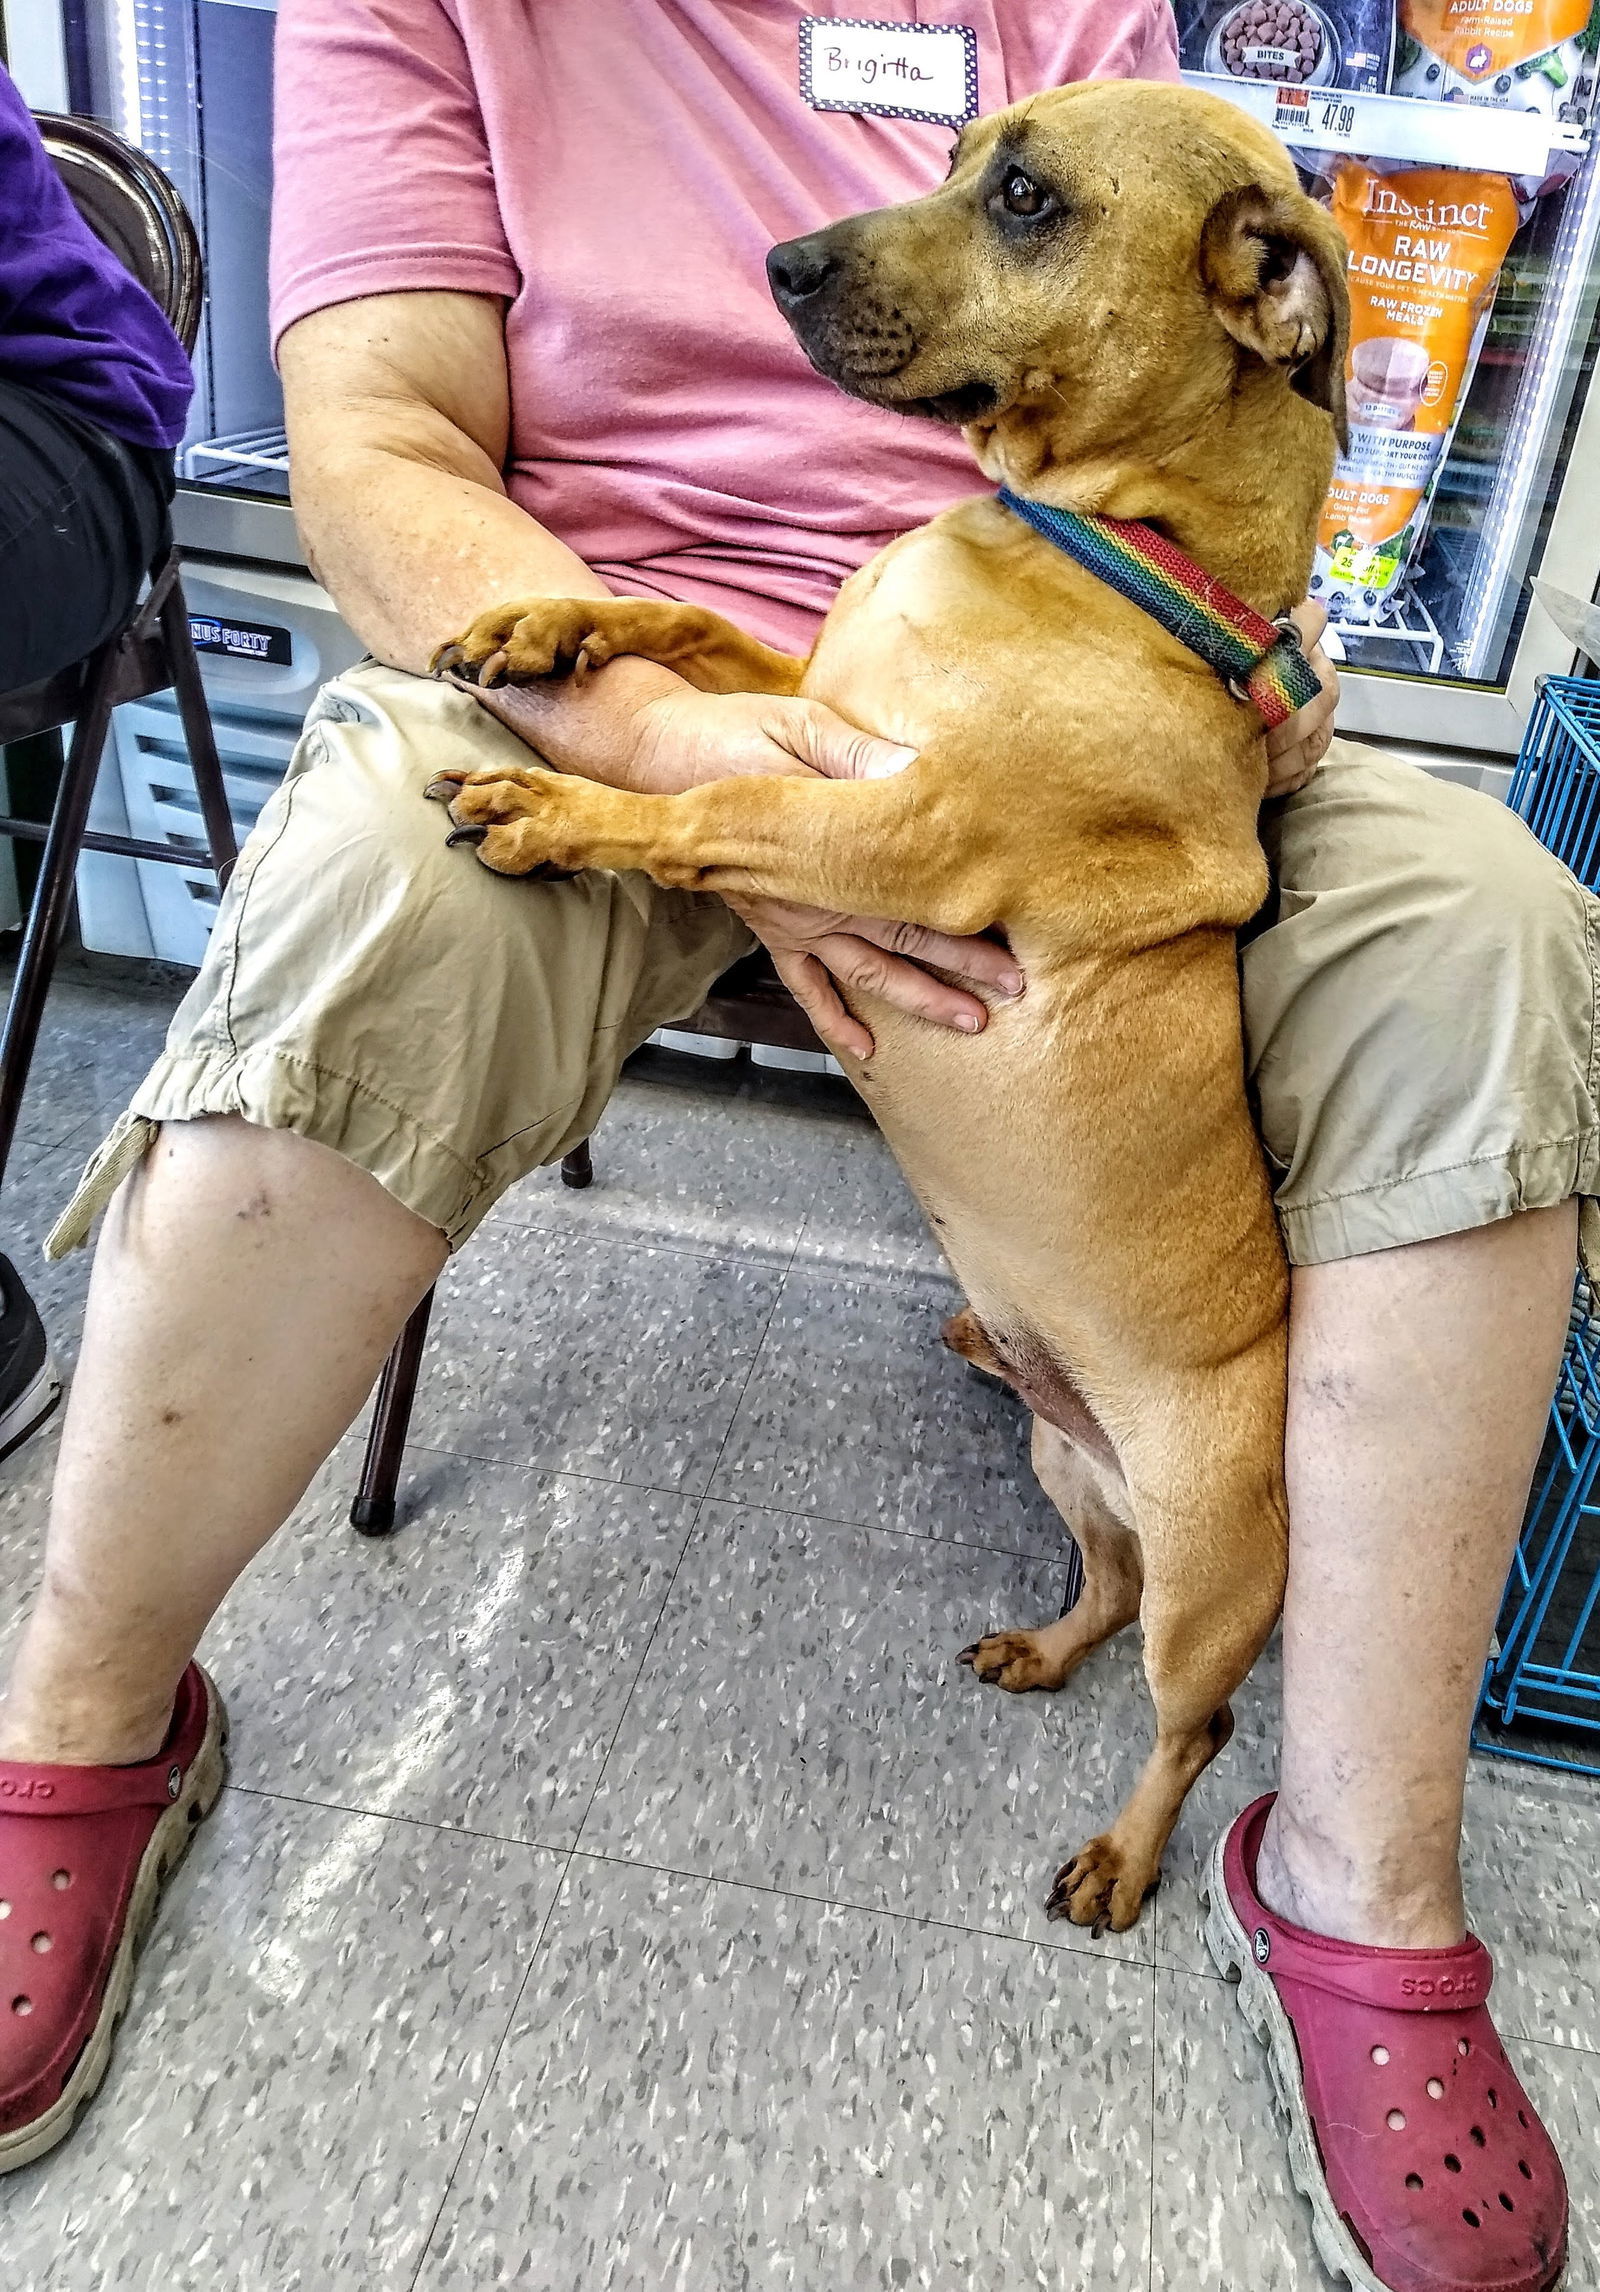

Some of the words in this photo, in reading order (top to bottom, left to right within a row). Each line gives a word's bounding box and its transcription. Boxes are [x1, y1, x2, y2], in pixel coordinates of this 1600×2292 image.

[1449, 0, 1490, 14] ADULT
[1492, 0, 1533, 14] DOGS
[1483, 27, 1515, 38] Recipe
[824, 46, 934, 85] Brigitta
[1256, 49, 1285, 62] BITES
[1322, 103, 1355, 133] 47.98
[1363, 177, 1491, 230] Instinct
[1408, 220, 1432, 233] RAW
[1394, 234, 1452, 262] RAW
[1347, 250, 1479, 293] LONGEVITY
[1370, 295, 1397, 309] RAW
[1399, 301, 1444, 318] FROZEN
[1386, 310, 1425, 326] MEALS
[1357, 432, 1387, 447] WITH
[1388, 438, 1432, 452] PURPOSE
[1354, 446, 1364, 455] TO
[1400, 452, 1418, 461] YOUR
[1358, 492, 1390, 505] DOGS
[222, 628, 273, 651] FORTY
[1400, 1973, 1477, 1997] crocs
